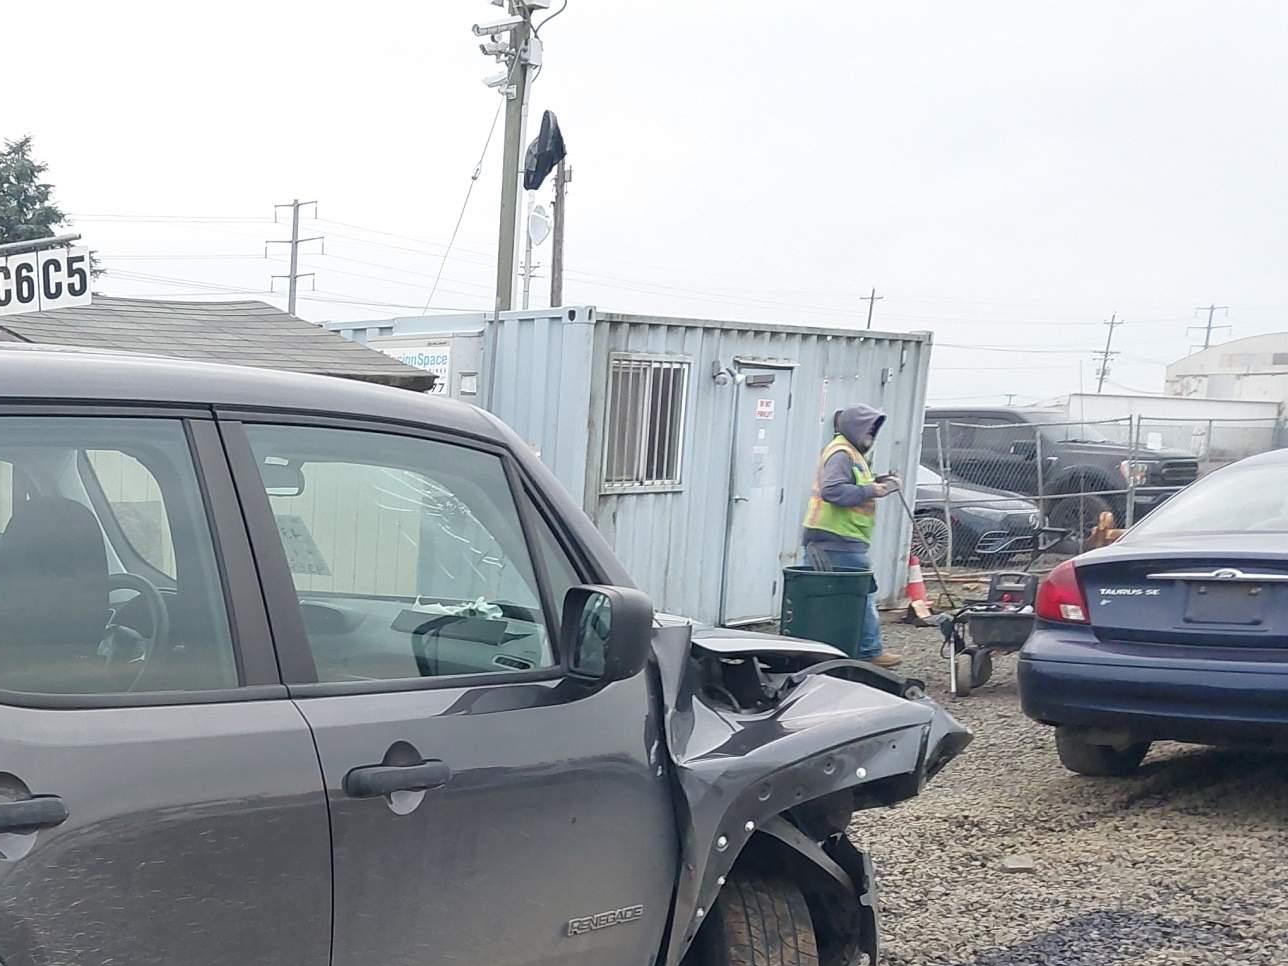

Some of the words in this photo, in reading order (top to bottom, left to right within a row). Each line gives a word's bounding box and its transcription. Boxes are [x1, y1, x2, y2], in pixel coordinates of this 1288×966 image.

[1099, 588, 1144, 596] TAURUS
[1145, 588, 1161, 596] SE
[568, 904, 644, 936] RENEGADE
